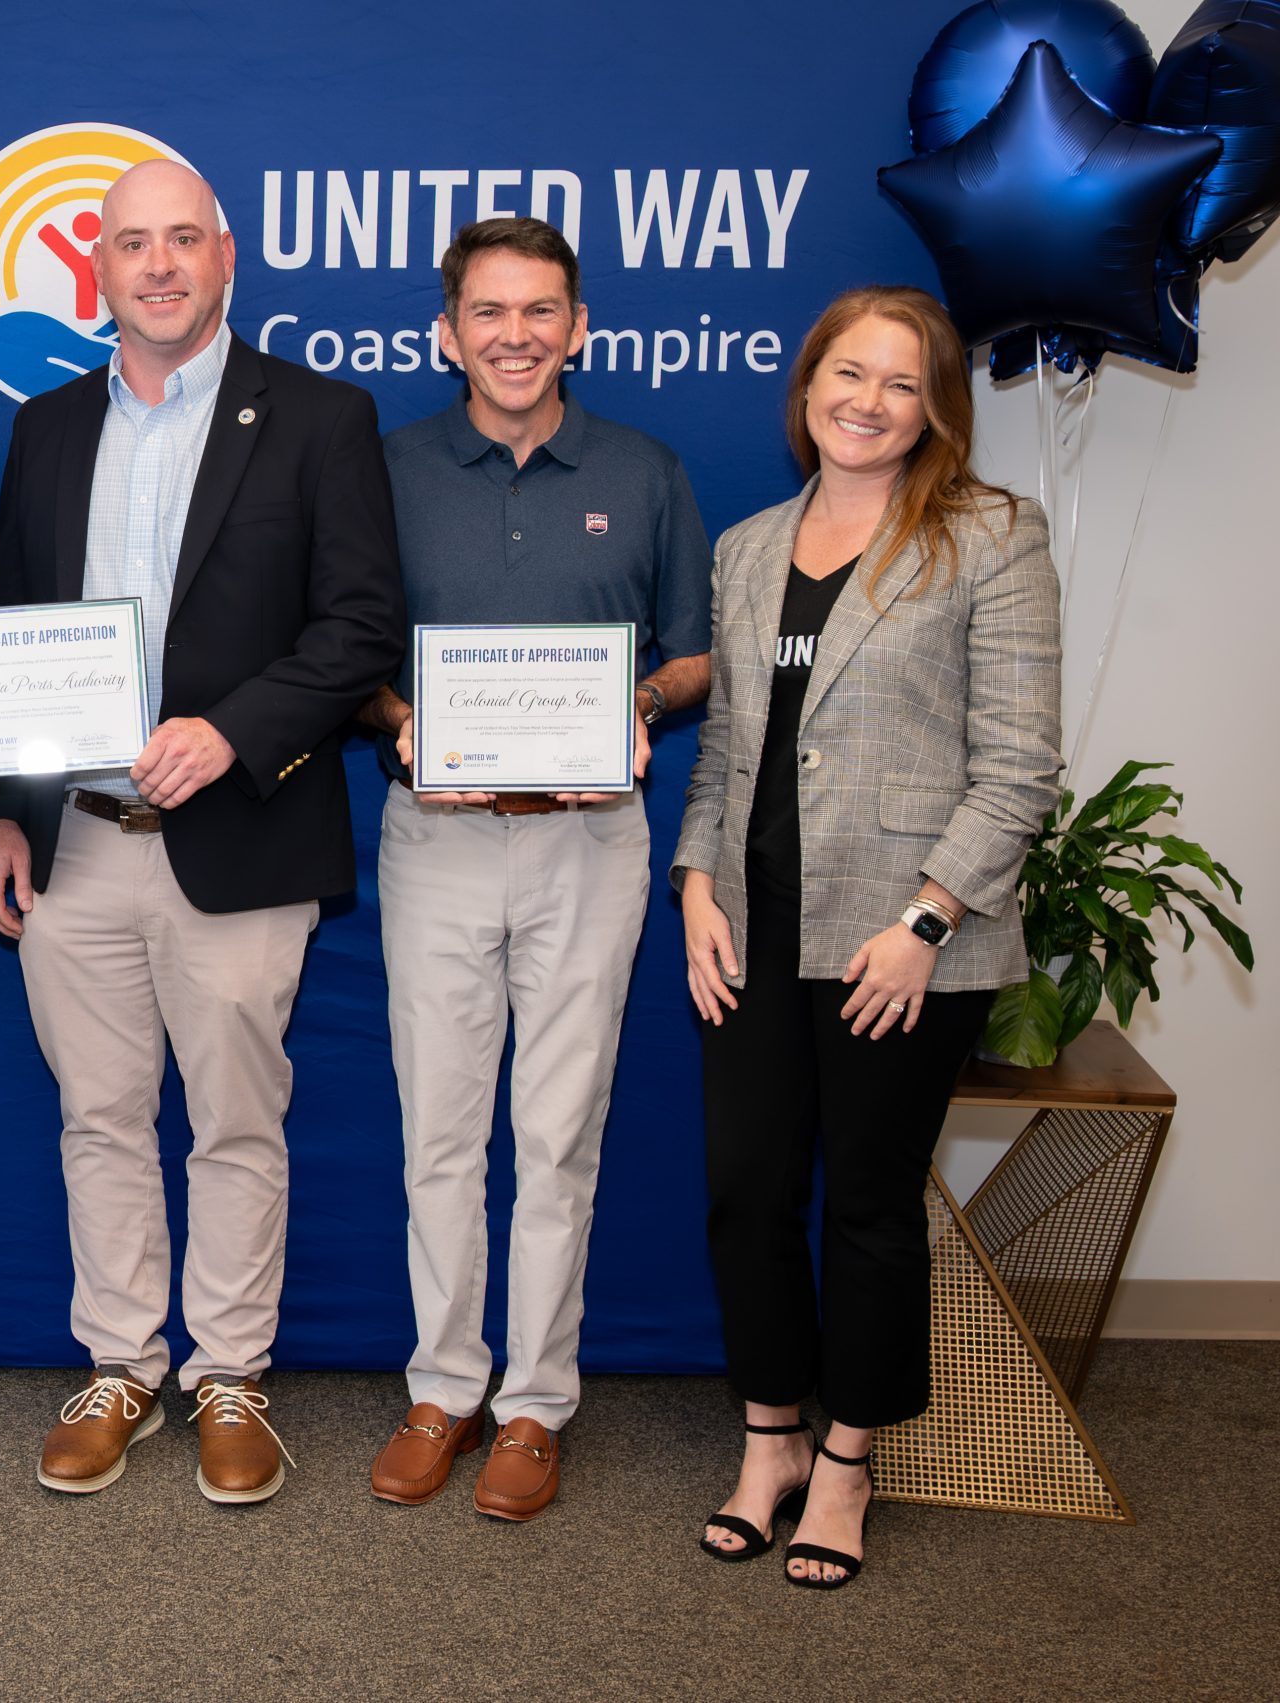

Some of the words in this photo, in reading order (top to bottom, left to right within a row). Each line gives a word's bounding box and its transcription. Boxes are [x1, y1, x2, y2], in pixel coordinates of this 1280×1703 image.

[262, 169, 583, 270] UNITED
[613, 169, 810, 269] WAY
[258, 313, 465, 373] Coast
[562, 313, 782, 389] mpire
[22, 630, 35, 645] OF
[38, 625, 117, 644] APPRECIATION
[441, 648, 509, 663] CERTIFICATE
[511, 648, 525, 663] OF
[528, 647, 608, 663] APPRECIATION
[775, 635, 821, 667] UN
[10, 674, 54, 695] Ports
[54, 667, 127, 692] Authority
[449, 689, 519, 709] Colonial
[571, 688, 602, 708] Inc.
[4, 736, 17, 745] WAY
[463, 753, 485, 761] UNITED
[485, 753, 499, 761] WAY
